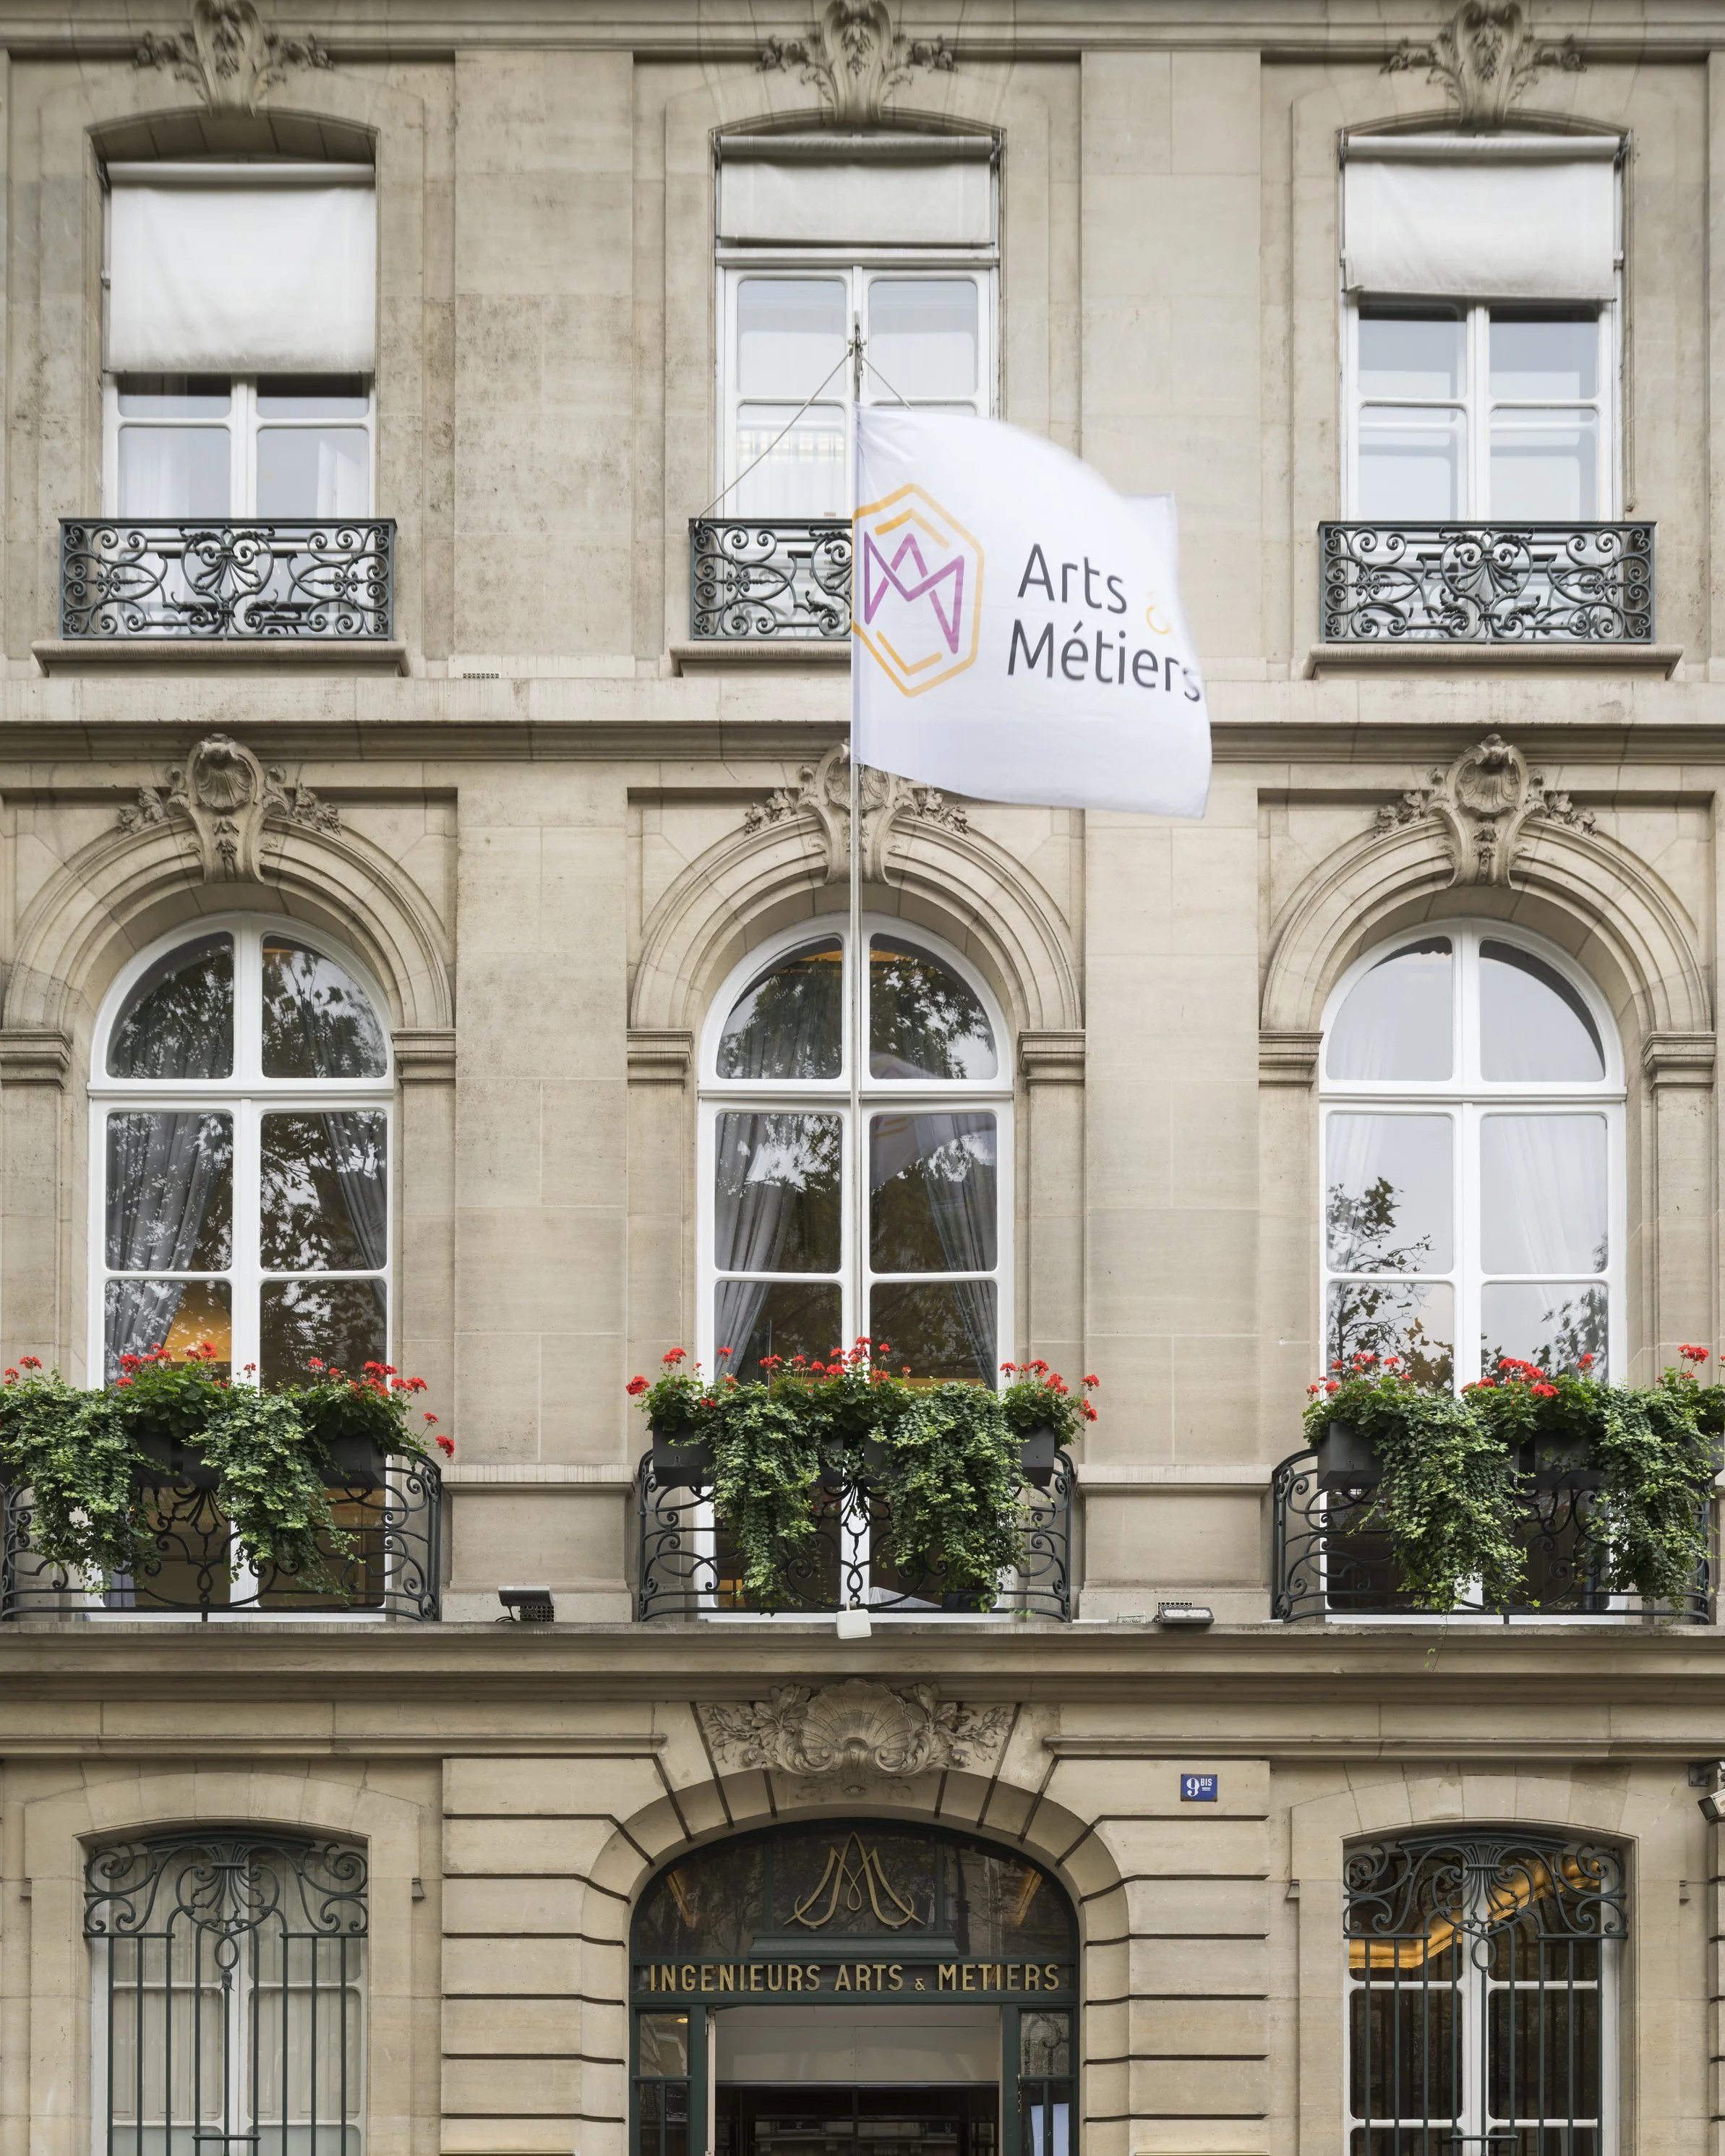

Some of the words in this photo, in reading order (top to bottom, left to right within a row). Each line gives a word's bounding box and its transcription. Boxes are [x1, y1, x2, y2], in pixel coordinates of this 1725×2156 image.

[1016, 543, 1128, 615] Arts
[1007, 620, 1201, 702] Métiers
[649, 1964, 822, 1992] INGENIEURS
[834, 1964, 904, 1991] ARTS
[914, 1977, 926, 1991] &
[938, 1963, 1060, 1991] METIERS
